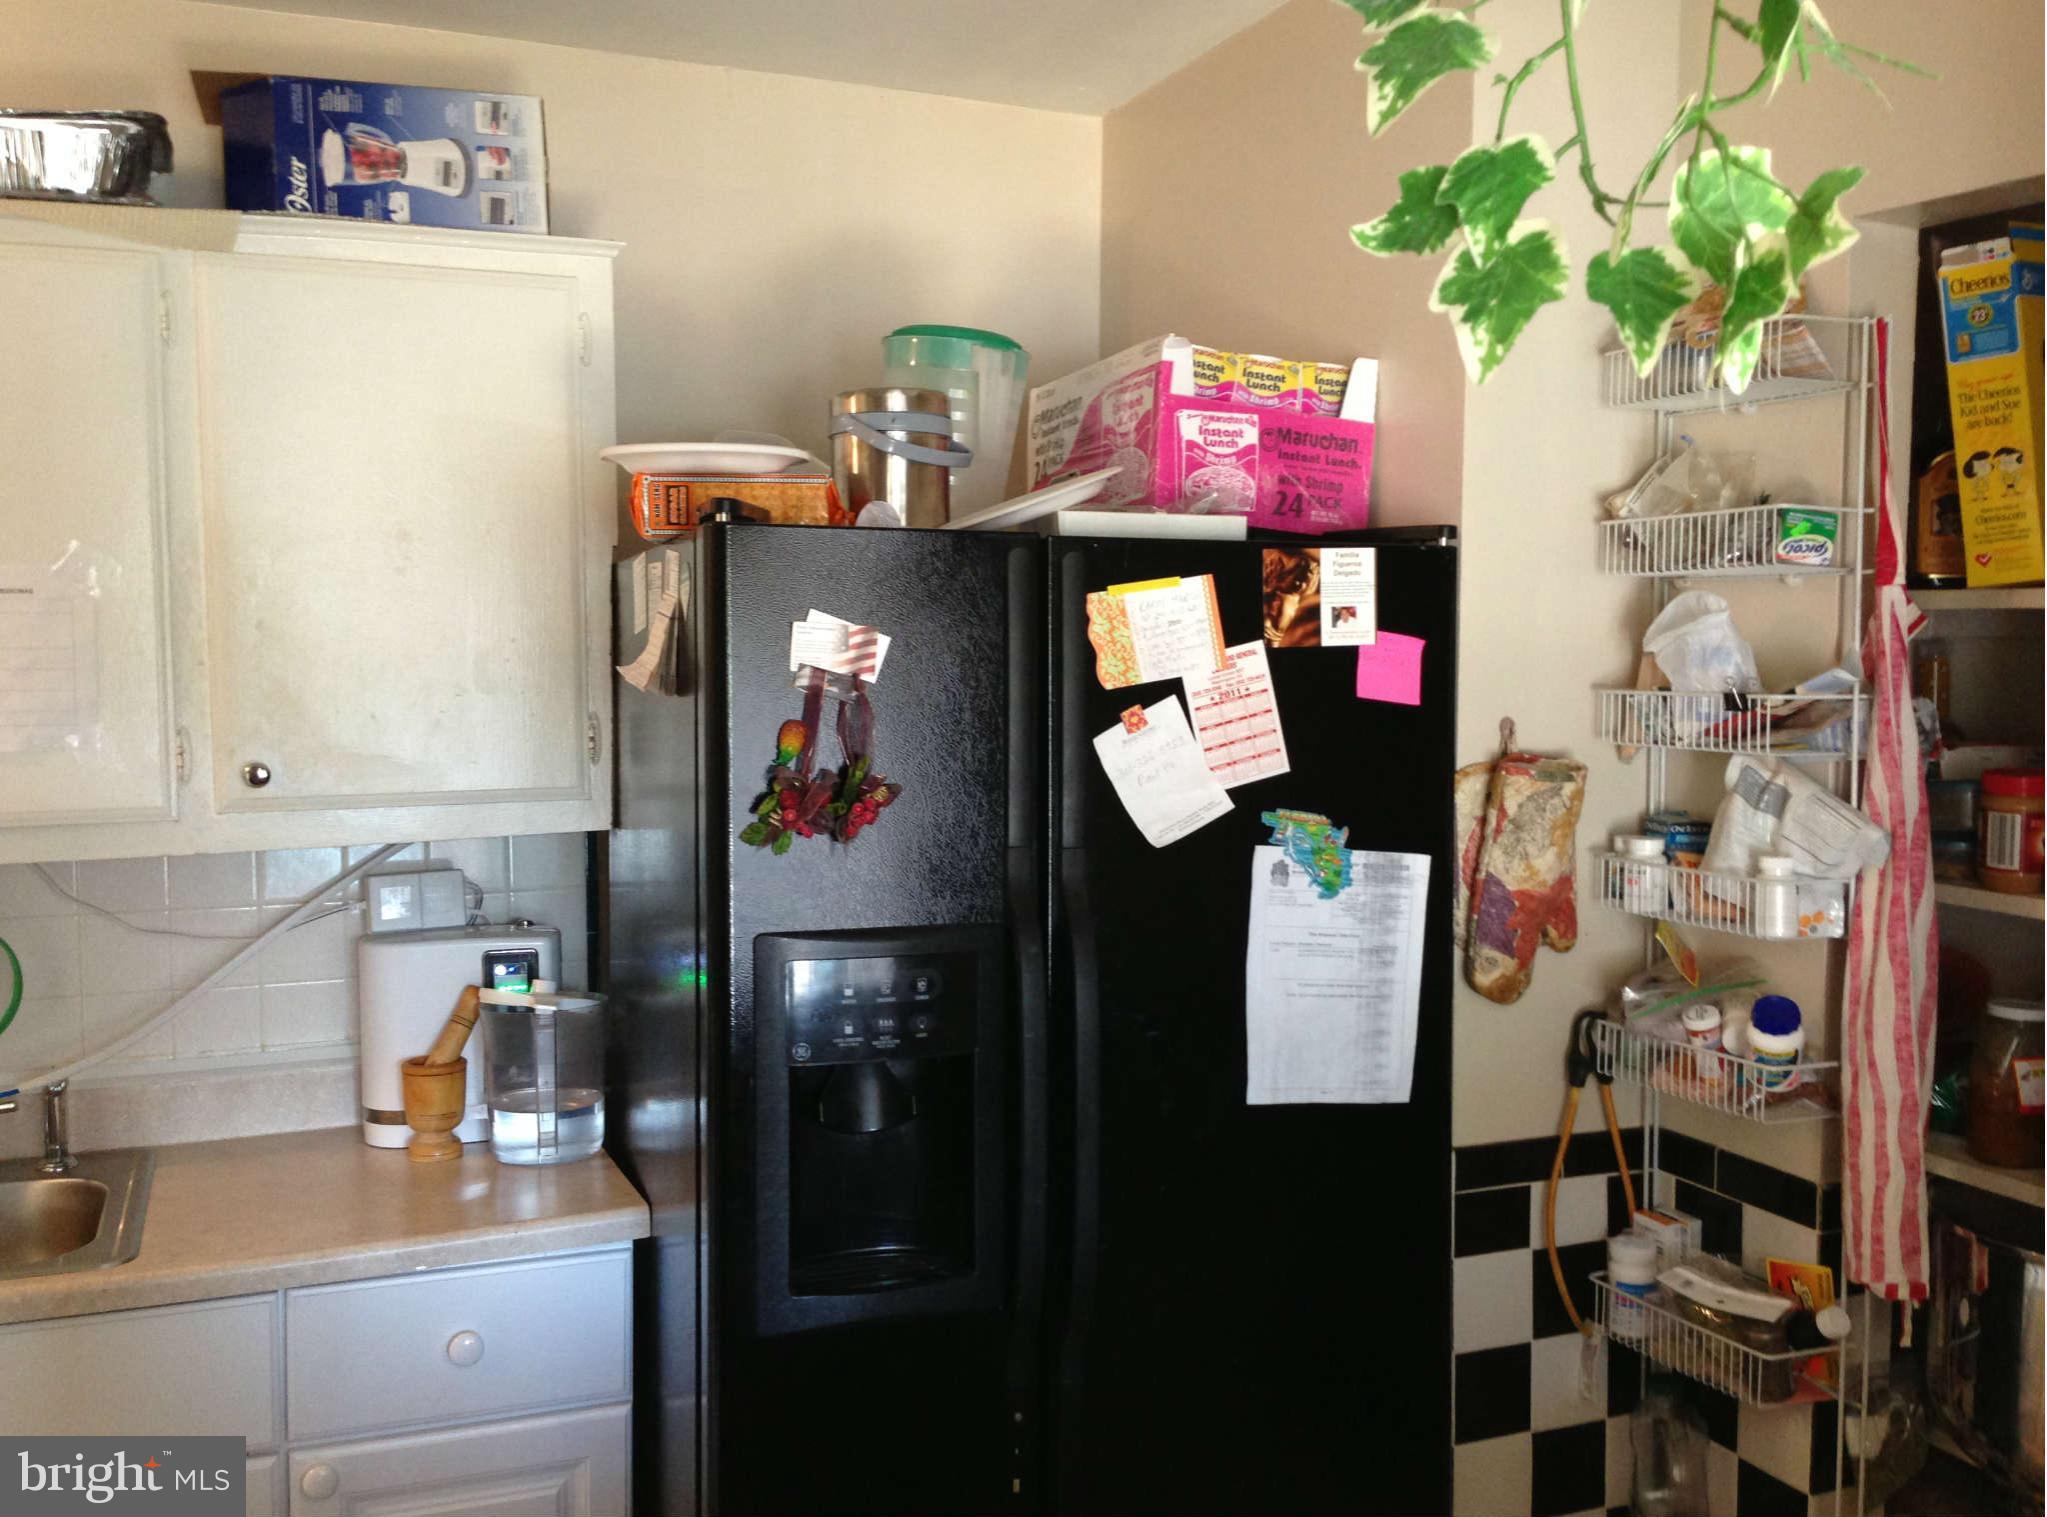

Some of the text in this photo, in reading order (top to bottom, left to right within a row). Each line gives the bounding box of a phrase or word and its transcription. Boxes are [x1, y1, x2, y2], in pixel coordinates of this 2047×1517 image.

[285, 156, 314, 213] Oster
[1951, 273, 2011, 296] Cheerios
[1193, 359, 1225, 375] stant
[1193, 370, 1220, 384] unch
[1243, 367, 1287, 384] Instant
[1246, 377, 1281, 393] Lunch
[1198, 425, 1244, 439] Instant
[1277, 427, 1359, 452] Maruchan
[1203, 435, 1239, 449] Lunch
[1278, 448, 1321, 464] Instant
[1305, 476, 1344, 493] Shrimp
[1272, 490, 1305, 519] 24
[1308, 493, 1343, 509] PACK
[1218, 687, 1241, 700] 2011
